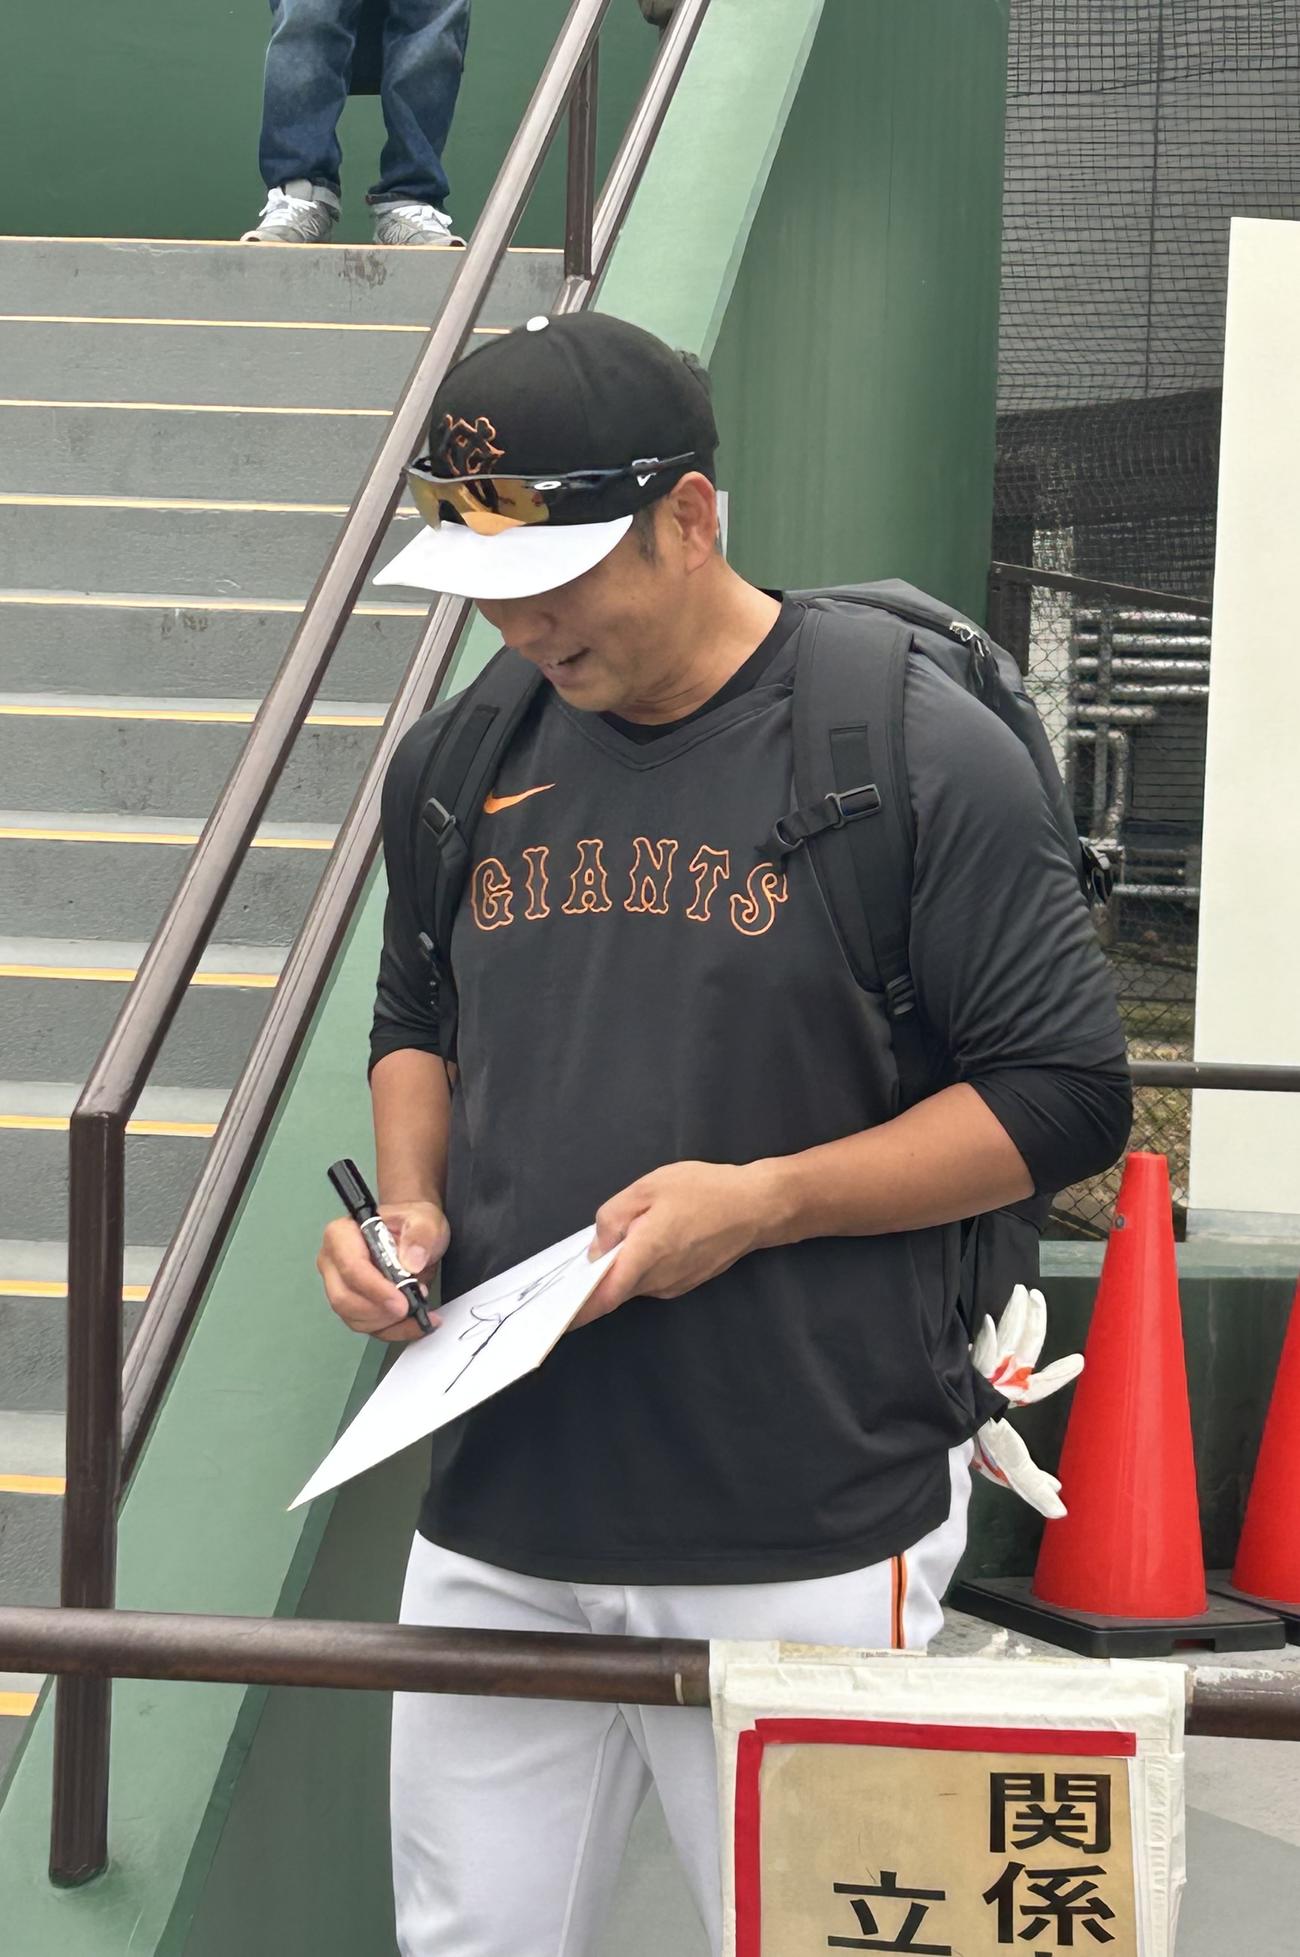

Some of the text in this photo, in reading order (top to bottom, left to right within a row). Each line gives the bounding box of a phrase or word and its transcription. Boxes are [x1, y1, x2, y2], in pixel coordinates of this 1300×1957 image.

[471, 837, 789, 936] GIANTS
[828, 1870, 952, 1956] 立
[982, 1772, 1115, 1957] 関係
